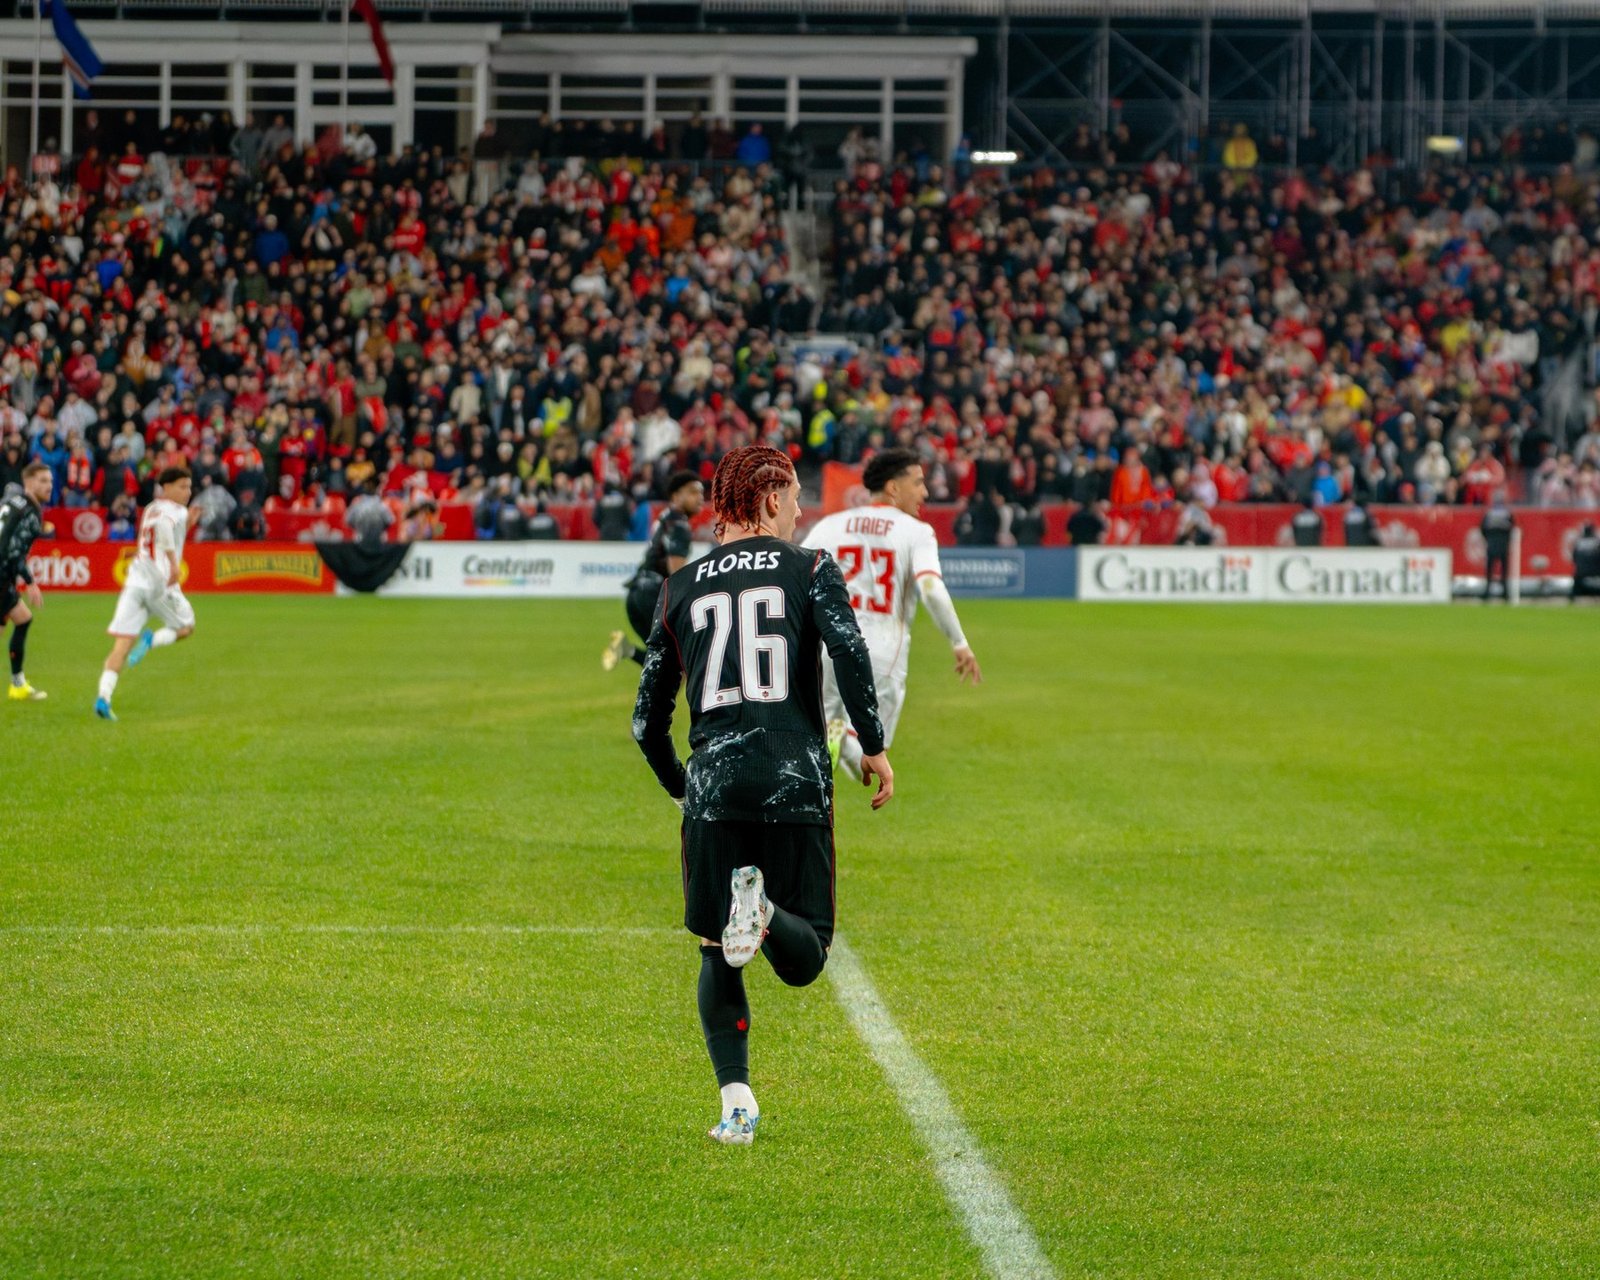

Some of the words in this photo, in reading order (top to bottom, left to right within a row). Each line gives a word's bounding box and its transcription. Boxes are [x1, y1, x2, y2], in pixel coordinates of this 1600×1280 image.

[29, 549, 90, 586] erios
[463, 554, 554, 576] Centrum
[695, 551, 781, 582] FLORES
[837, 545, 896, 615] 23
[1095, 553, 1249, 593] Canada
[1278, 555, 1433, 594] Canada
[690, 586, 789, 713] 26
